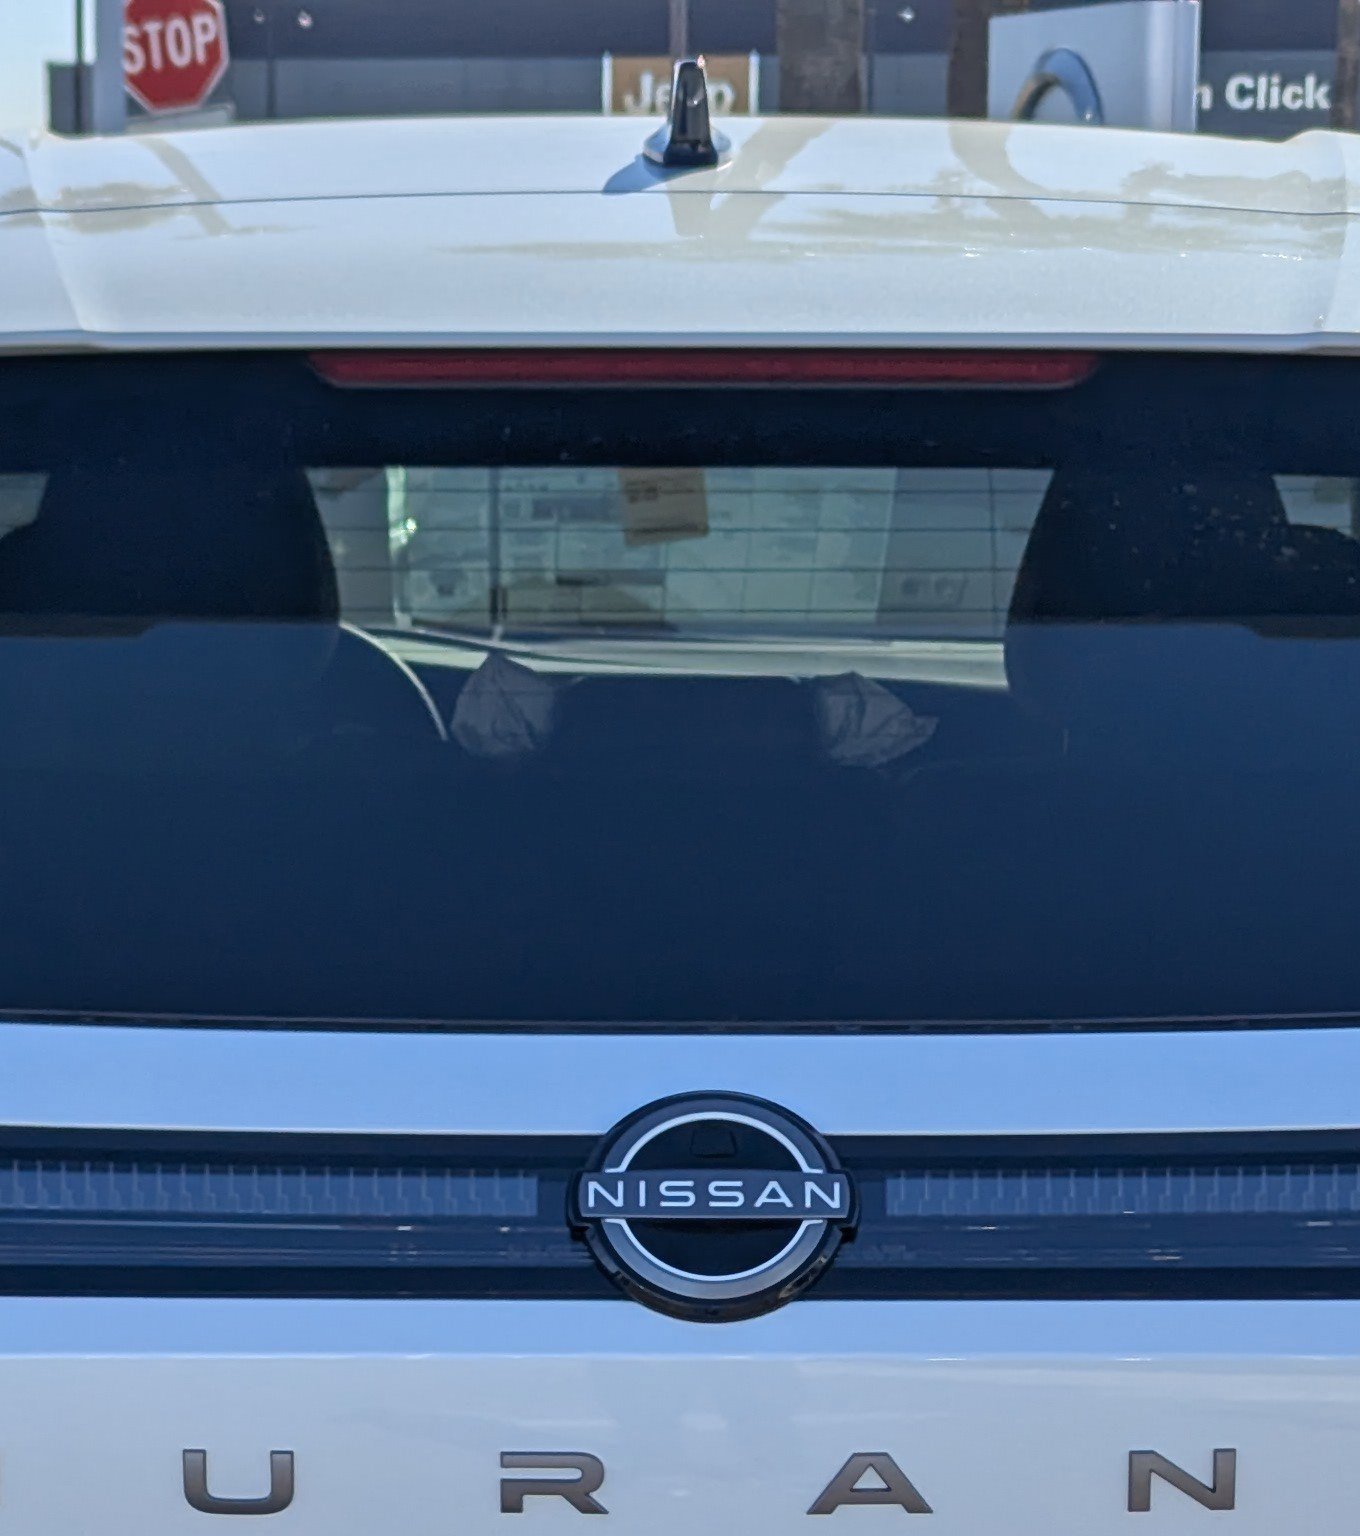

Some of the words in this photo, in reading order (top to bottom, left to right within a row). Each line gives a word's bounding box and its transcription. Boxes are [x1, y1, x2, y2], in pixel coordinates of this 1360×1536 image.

[123, 13, 217, 74] STOP
[1225, 72, 1330, 111] Click
[587, 1179, 841, 1209] NISSAN
